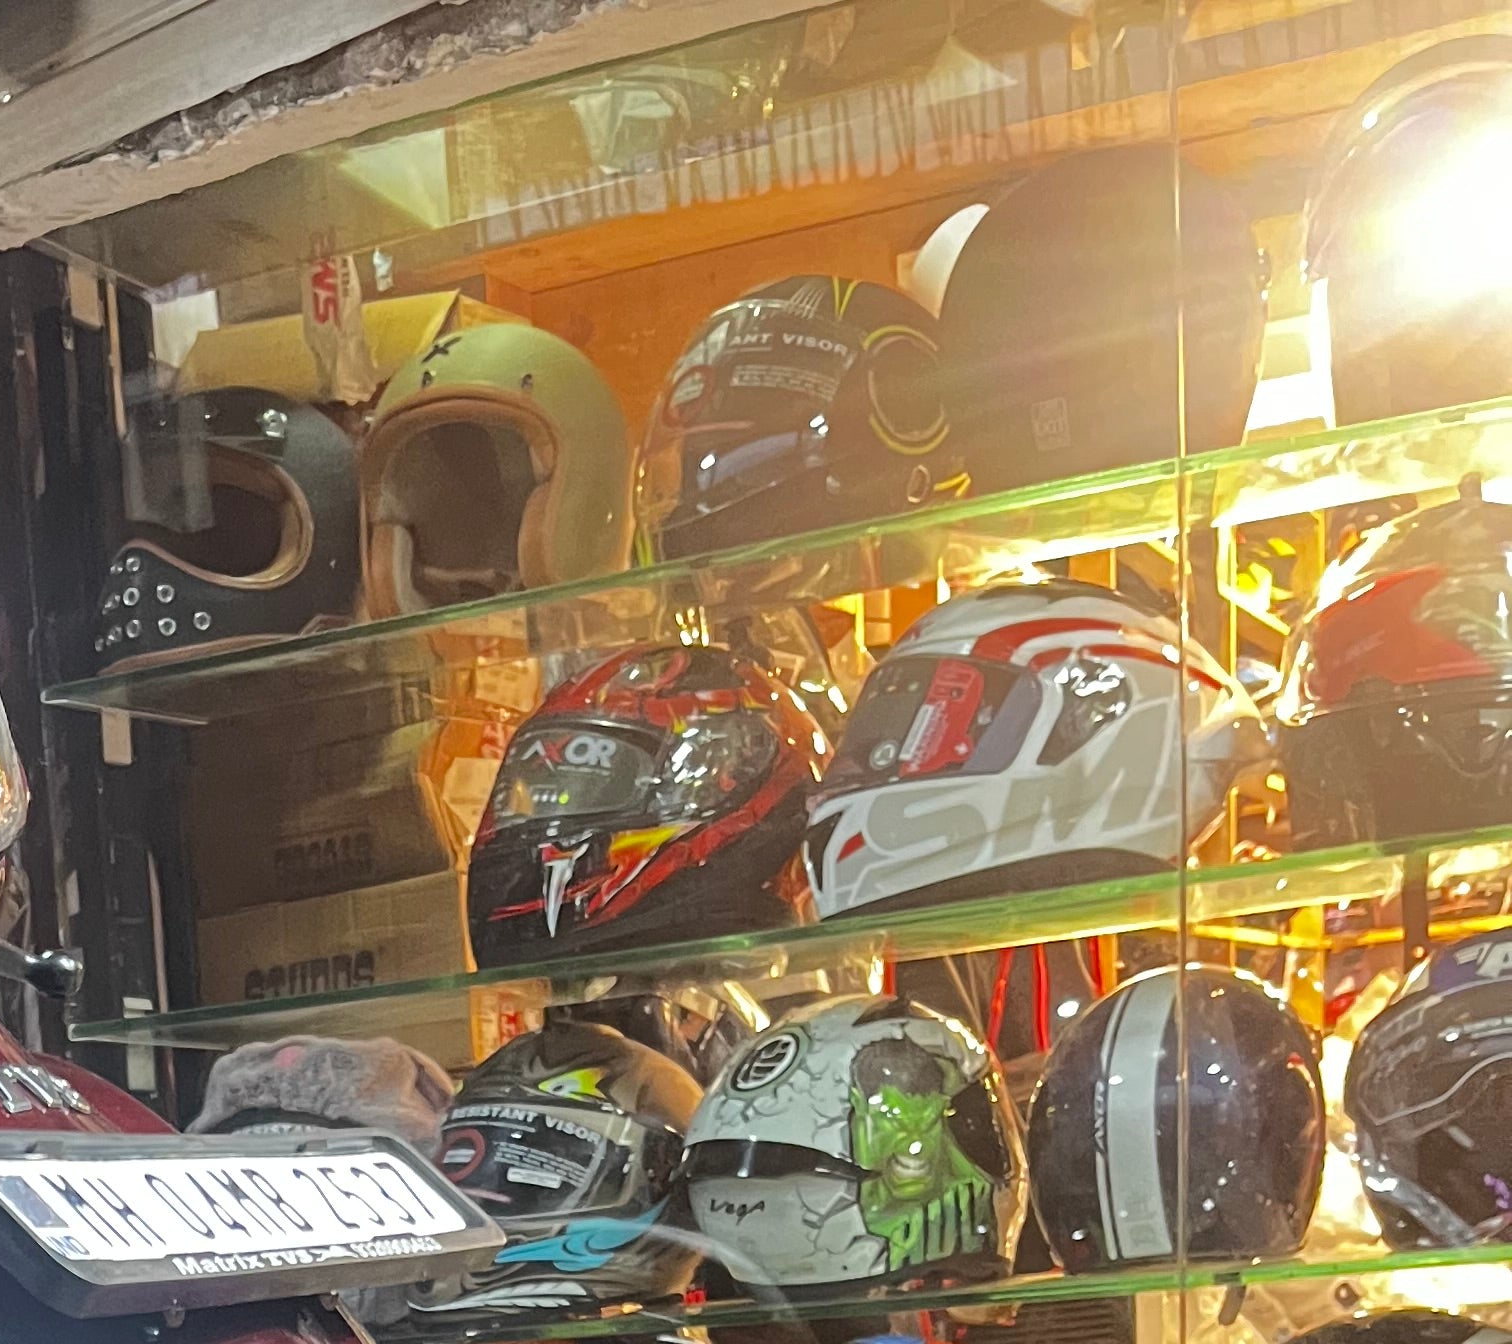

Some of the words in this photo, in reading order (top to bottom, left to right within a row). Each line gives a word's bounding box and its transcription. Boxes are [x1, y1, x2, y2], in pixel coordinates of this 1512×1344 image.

[728, 333, 773, 347] ANT
[781, 332, 849, 357] VISOR
[520, 735, 617, 773] AXOR
[544, 1114, 602, 1145] VISOR
[39, 1174, 168, 1248] MH
[292, 1162, 436, 1228] 2537
[172, 1252, 265, 1277] Matrix
[262, 1247, 316, 1268] TVS
